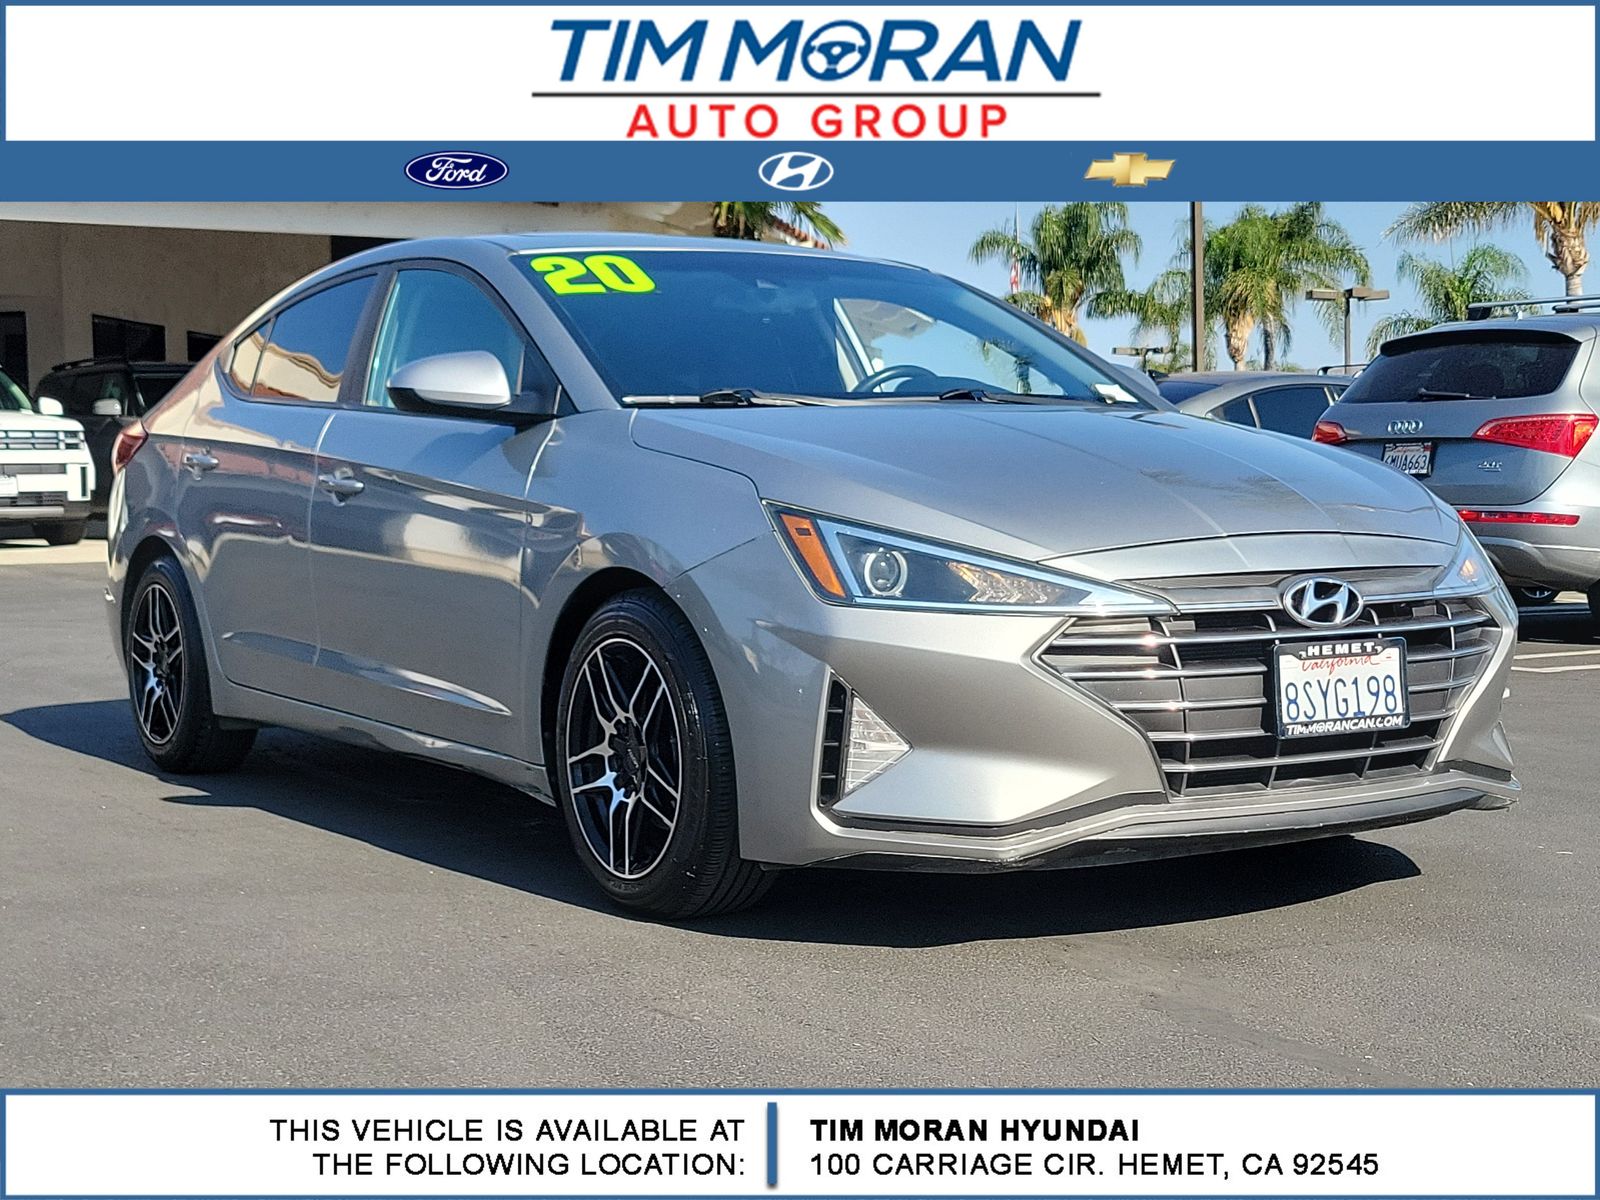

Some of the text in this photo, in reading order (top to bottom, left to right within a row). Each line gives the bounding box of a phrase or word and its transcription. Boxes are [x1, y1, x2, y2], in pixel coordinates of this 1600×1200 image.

[530, 254, 656, 295] 20
[1307, 641, 1375, 657] HEMET
[1285, 674, 1397, 721] 8SYG198
